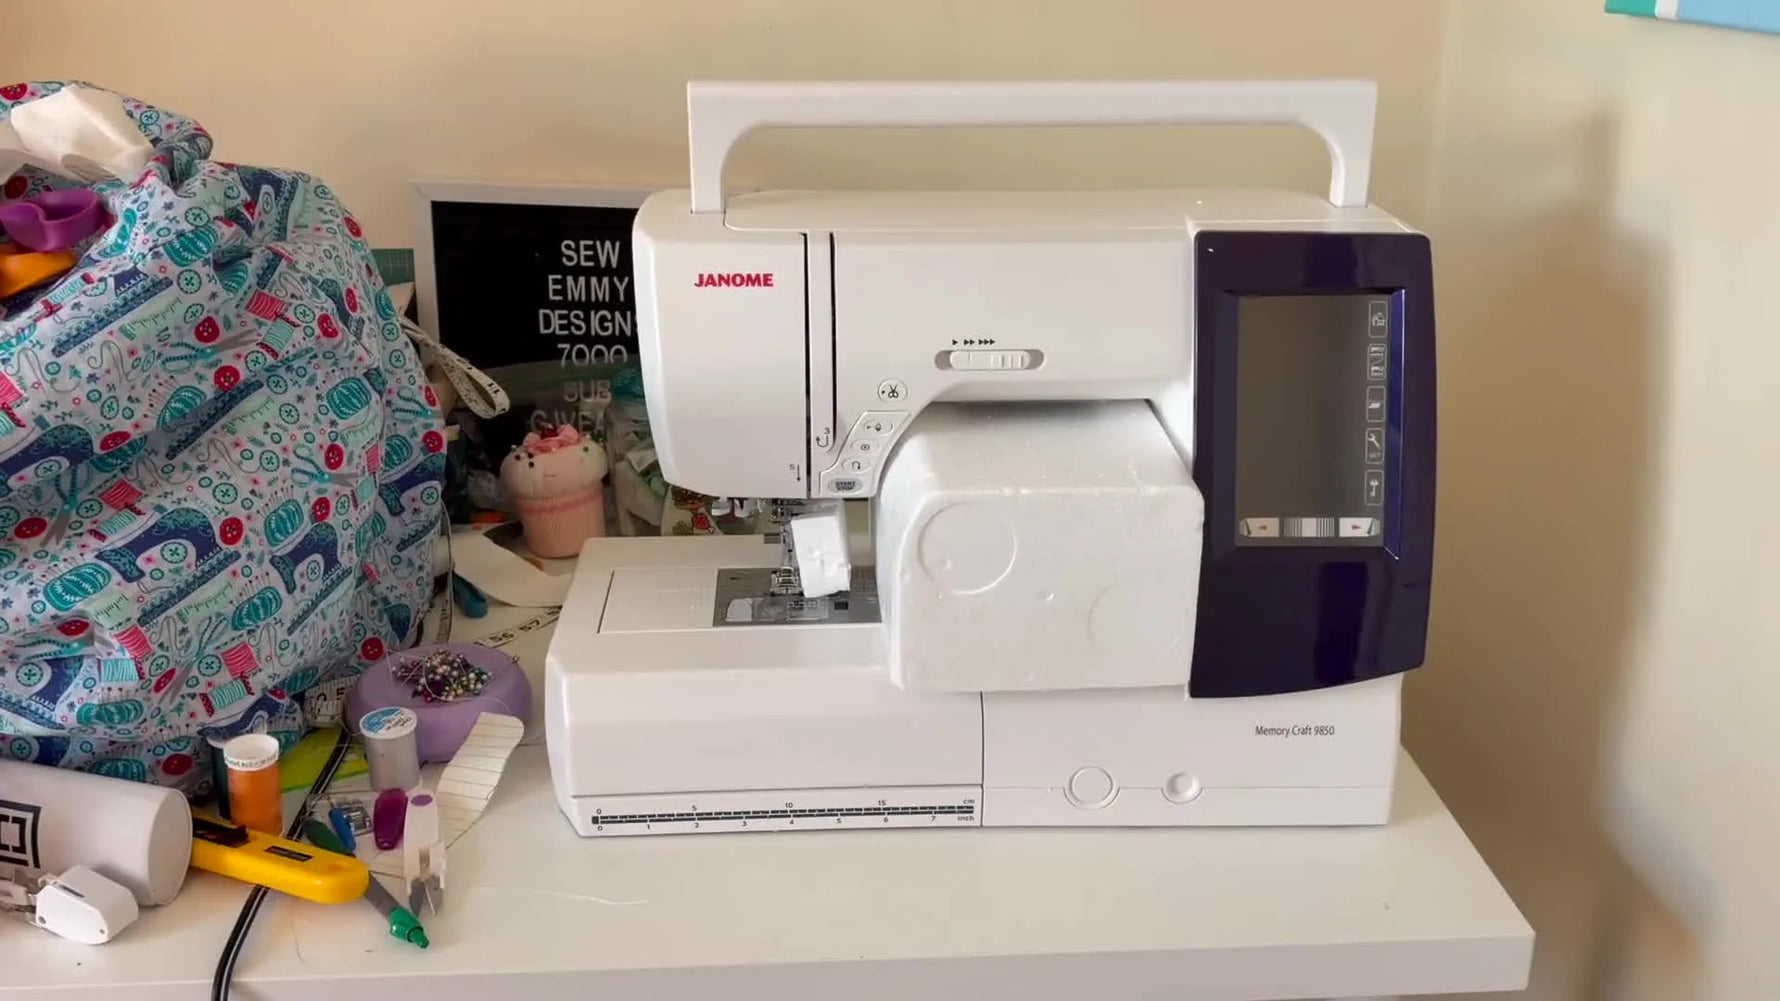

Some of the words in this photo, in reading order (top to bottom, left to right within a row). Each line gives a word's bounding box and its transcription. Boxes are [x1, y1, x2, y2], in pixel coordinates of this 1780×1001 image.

[561, 240, 620, 269] SEW
[549, 275, 629, 302] EMMY
[694, 273, 774, 287] JANOME
[539, 309, 639, 337] DESIGN
[557, 343, 628, 369] 7000
[1255, 725, 1290, 738] Memory
[1291, 725, 1312, 736] Craft
[1313, 725, 1335, 736] 9850
